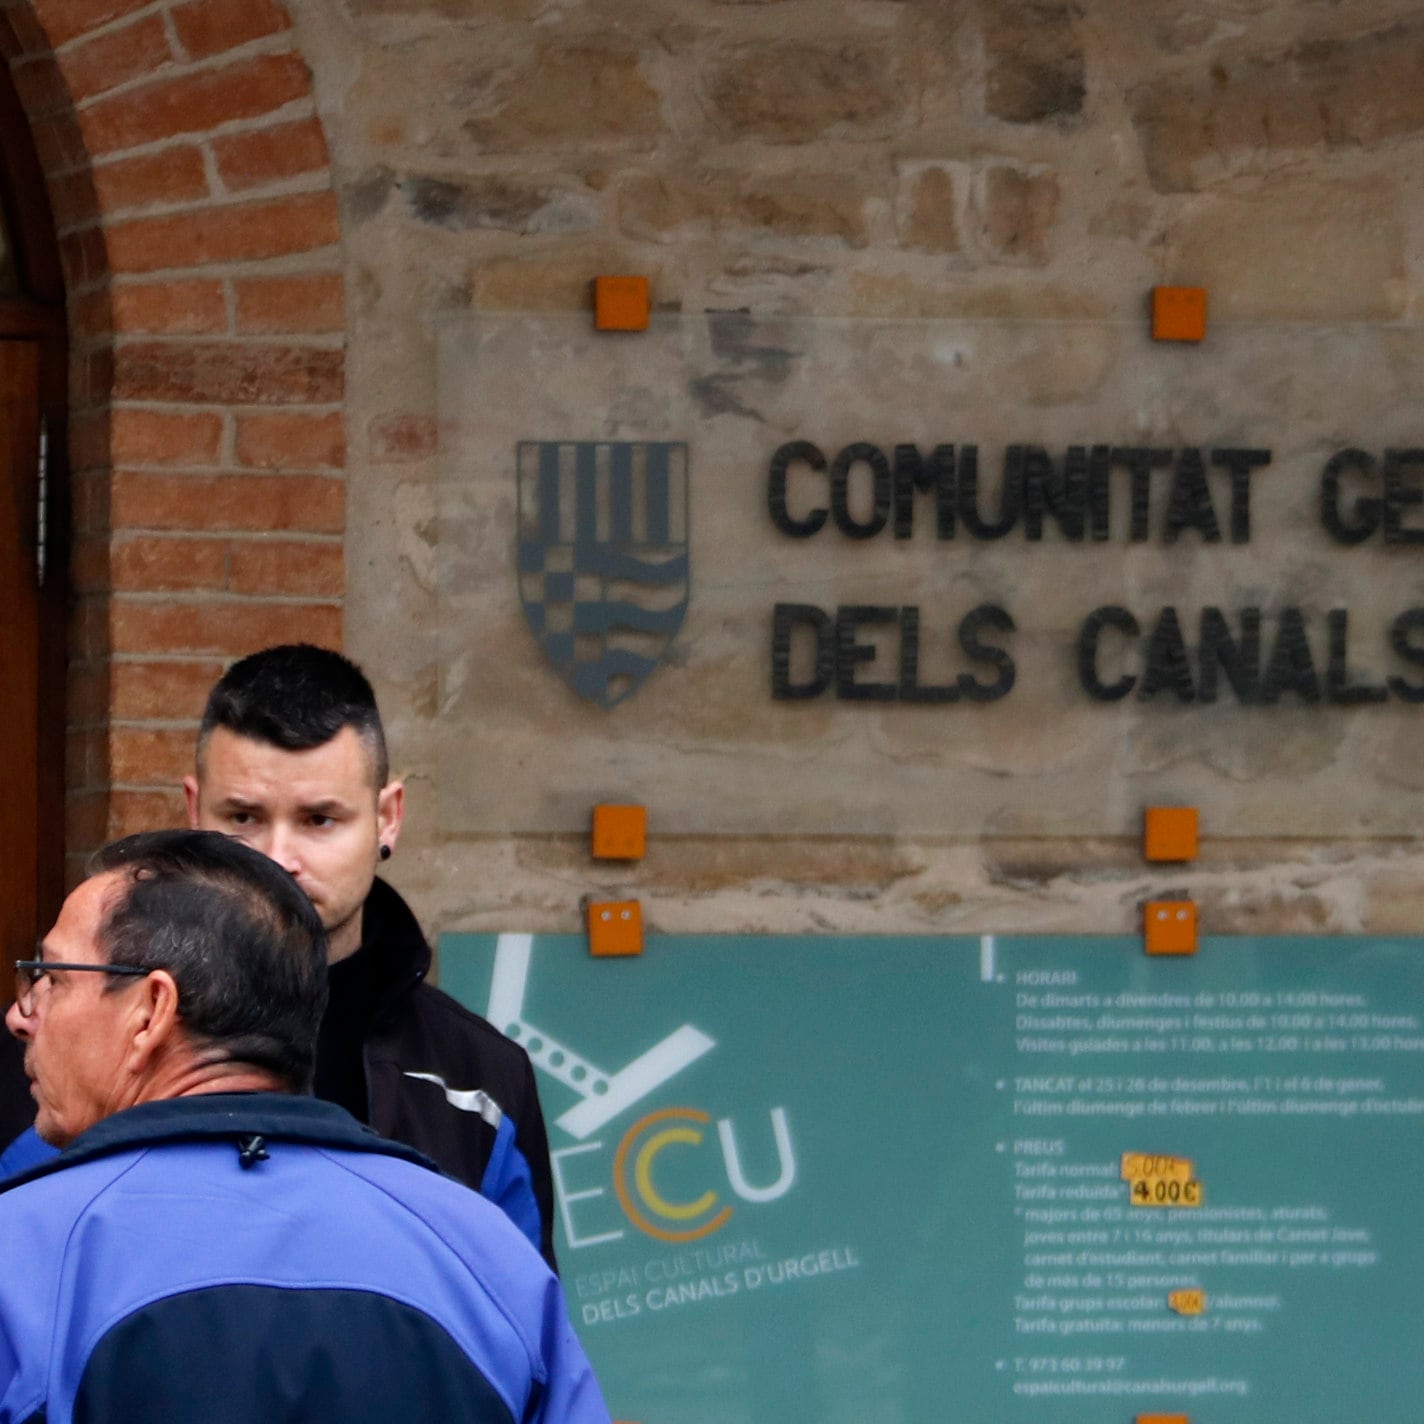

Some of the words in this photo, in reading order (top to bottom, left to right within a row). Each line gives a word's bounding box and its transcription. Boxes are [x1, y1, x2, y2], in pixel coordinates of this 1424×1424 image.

[769, 441, 1272, 544] COMUNITAT
[772, 603, 1016, 701] DELS
[1016, 970, 1076, 985] HORARI
[1014, 1078, 1076, 1092] TANCAT
[1014, 1140, 1064, 1154] PREUS
[576, 1266, 638, 1298] ESPAI
[644, 1239, 766, 1282] CULTURAL
[582, 1294, 640, 1325] DELS
[645, 1271, 739, 1311] CANALS
[744, 1247, 860, 1290] D'URGELL
